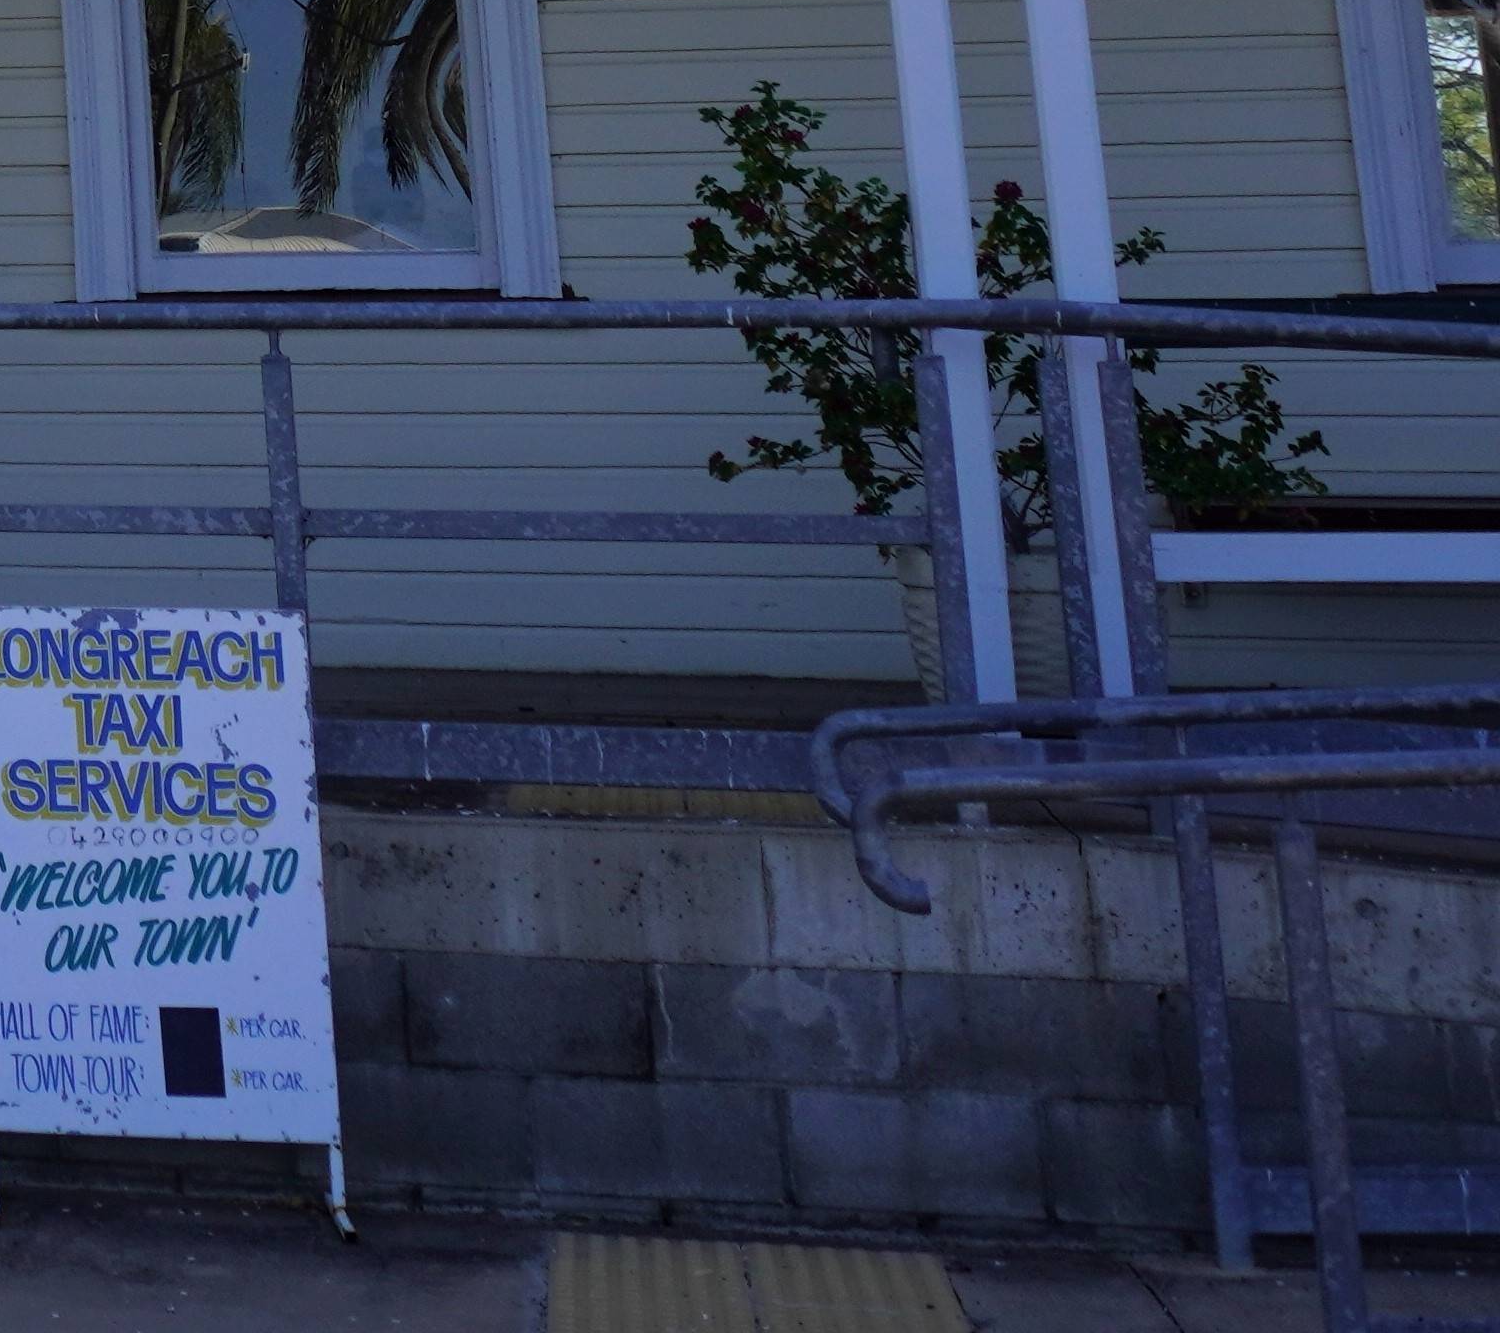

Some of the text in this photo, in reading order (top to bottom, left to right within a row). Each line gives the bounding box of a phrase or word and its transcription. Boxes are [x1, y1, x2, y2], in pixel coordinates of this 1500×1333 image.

[64, 693, 184, 754] TAXI
[2, 759, 277, 825] SERVICES
[187, 850, 252, 901] YOU
[260, 847, 299, 896] TO
[44, 922, 120, 973] OUR
[48, 1004, 80, 1042] OF
[11, 1052, 76, 1095] TOWN
